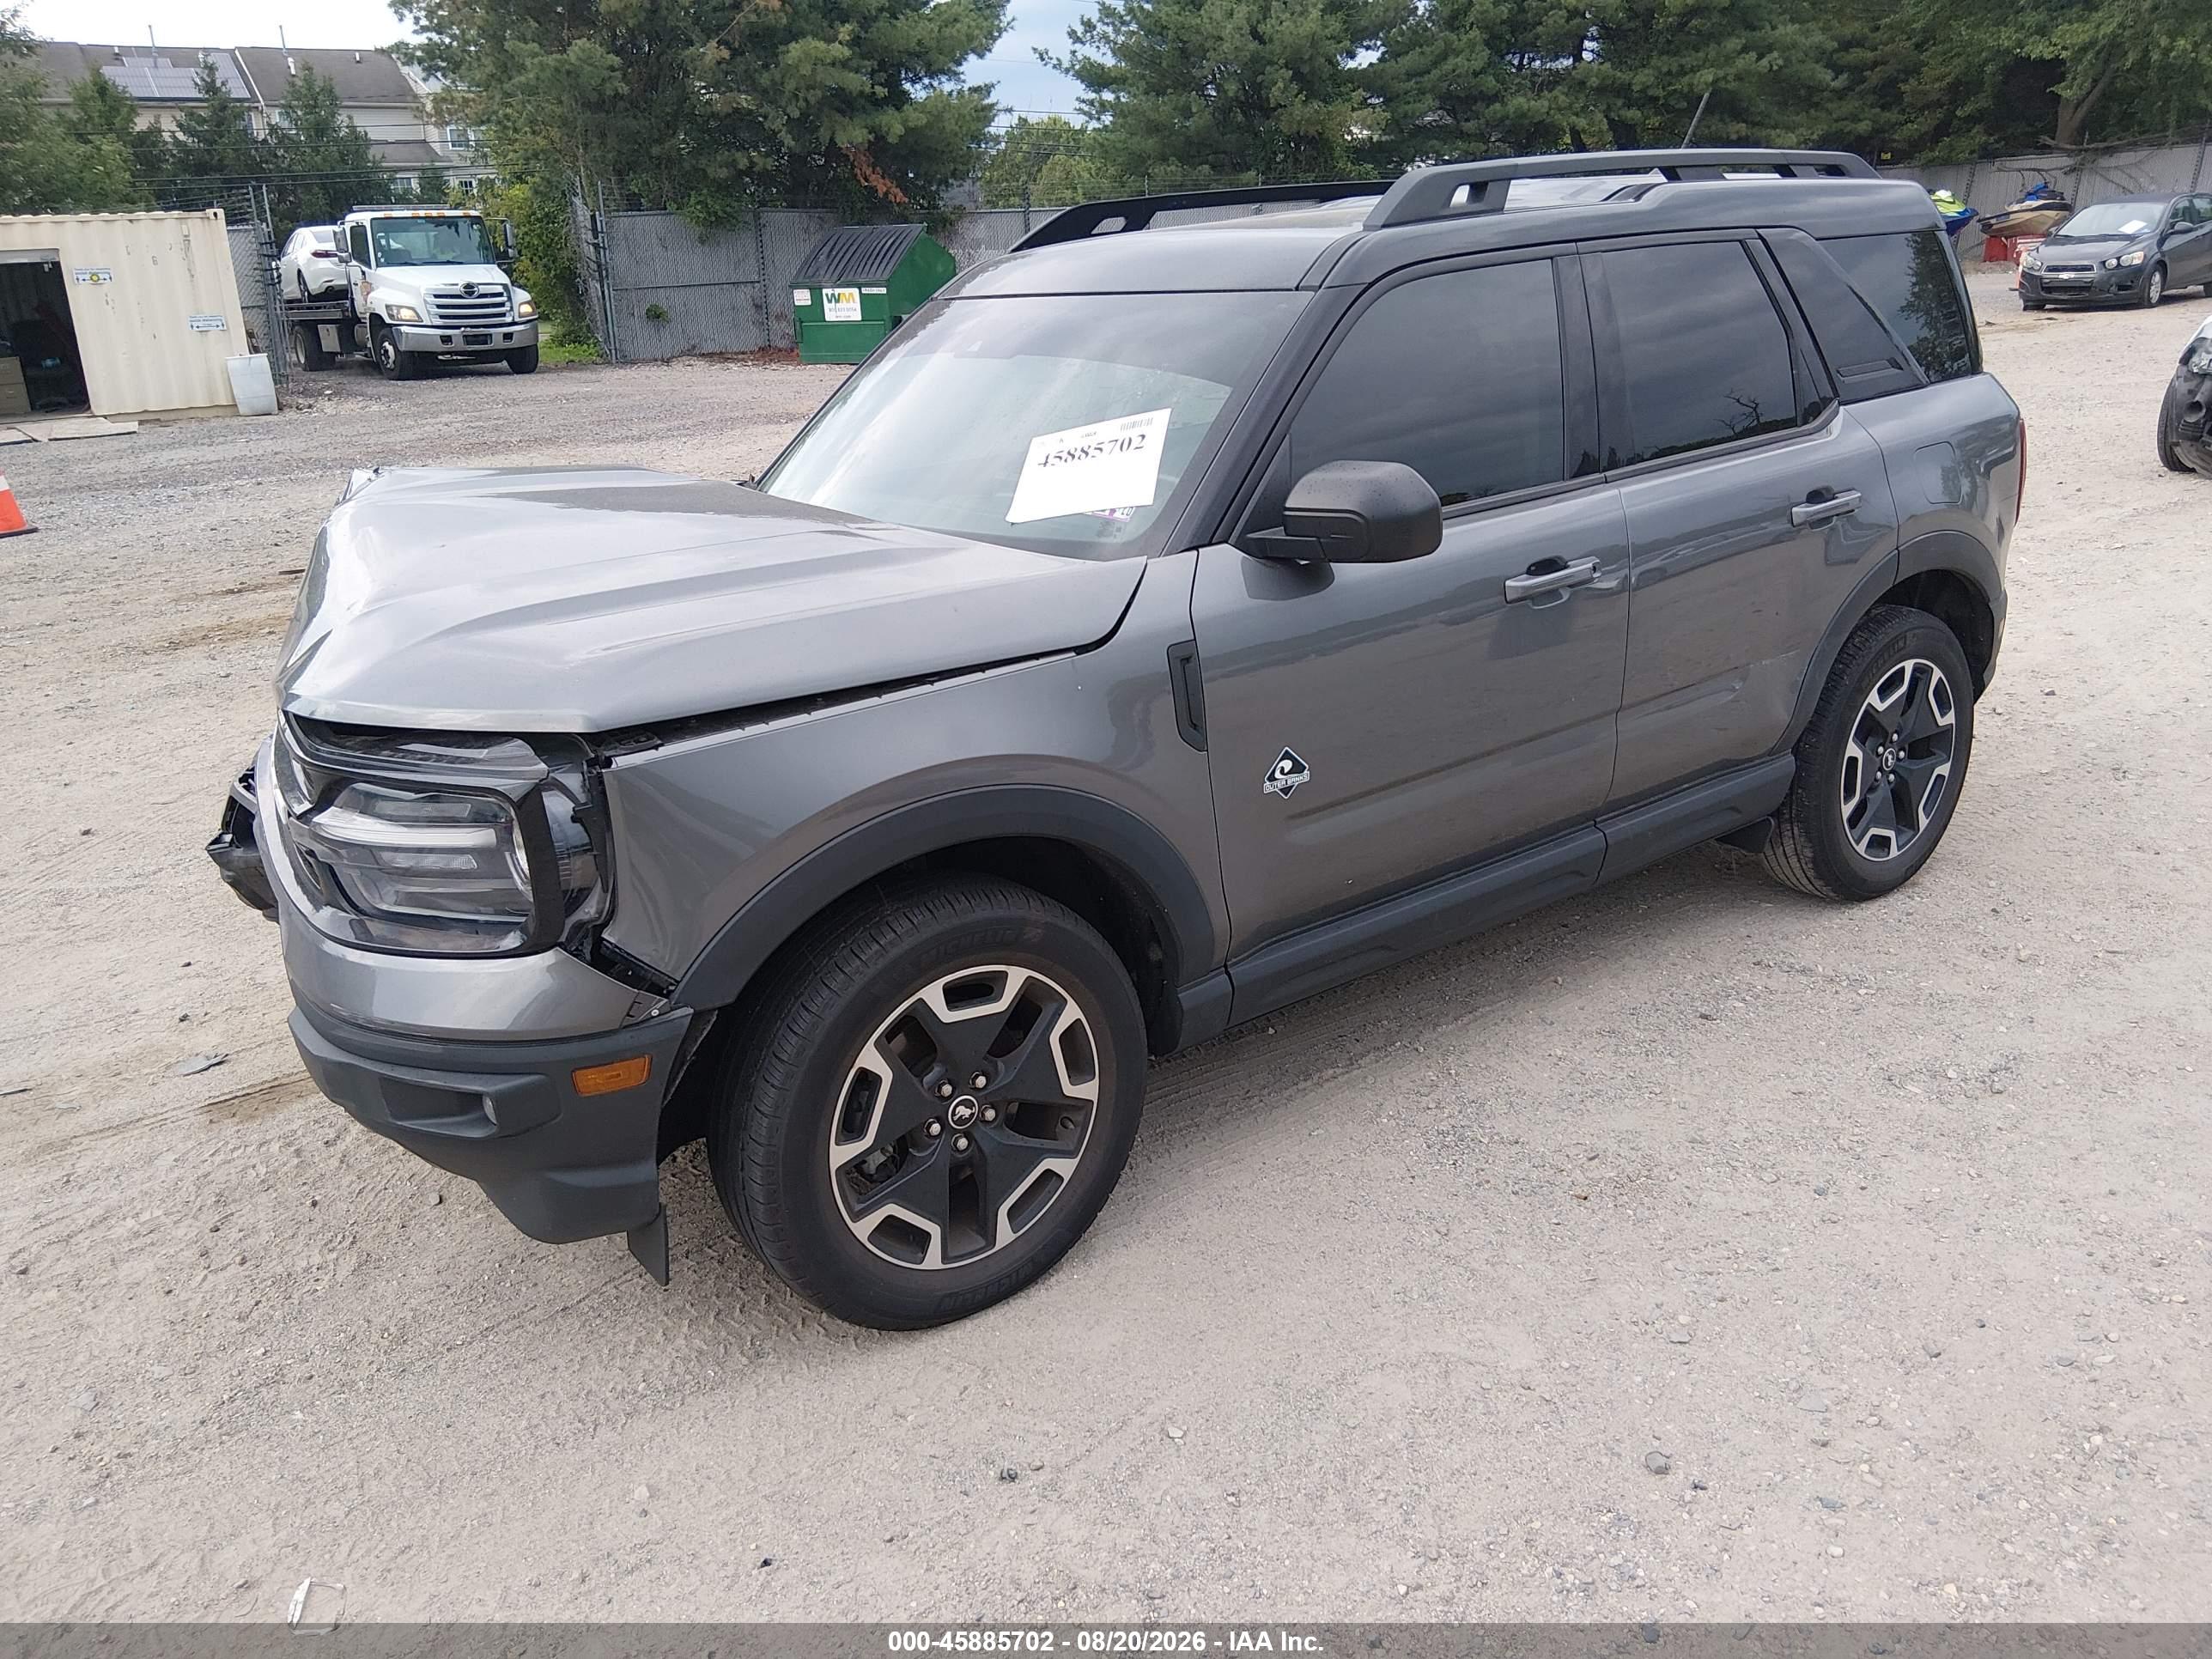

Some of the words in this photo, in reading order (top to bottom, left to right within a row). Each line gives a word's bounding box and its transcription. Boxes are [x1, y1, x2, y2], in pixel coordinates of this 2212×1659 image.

[824, 292, 856, 304] WM
[1036, 434, 1146, 468] 45885702
[1265, 780, 1286, 791] OUTER
[1287, 774, 1308, 785] BANKS
